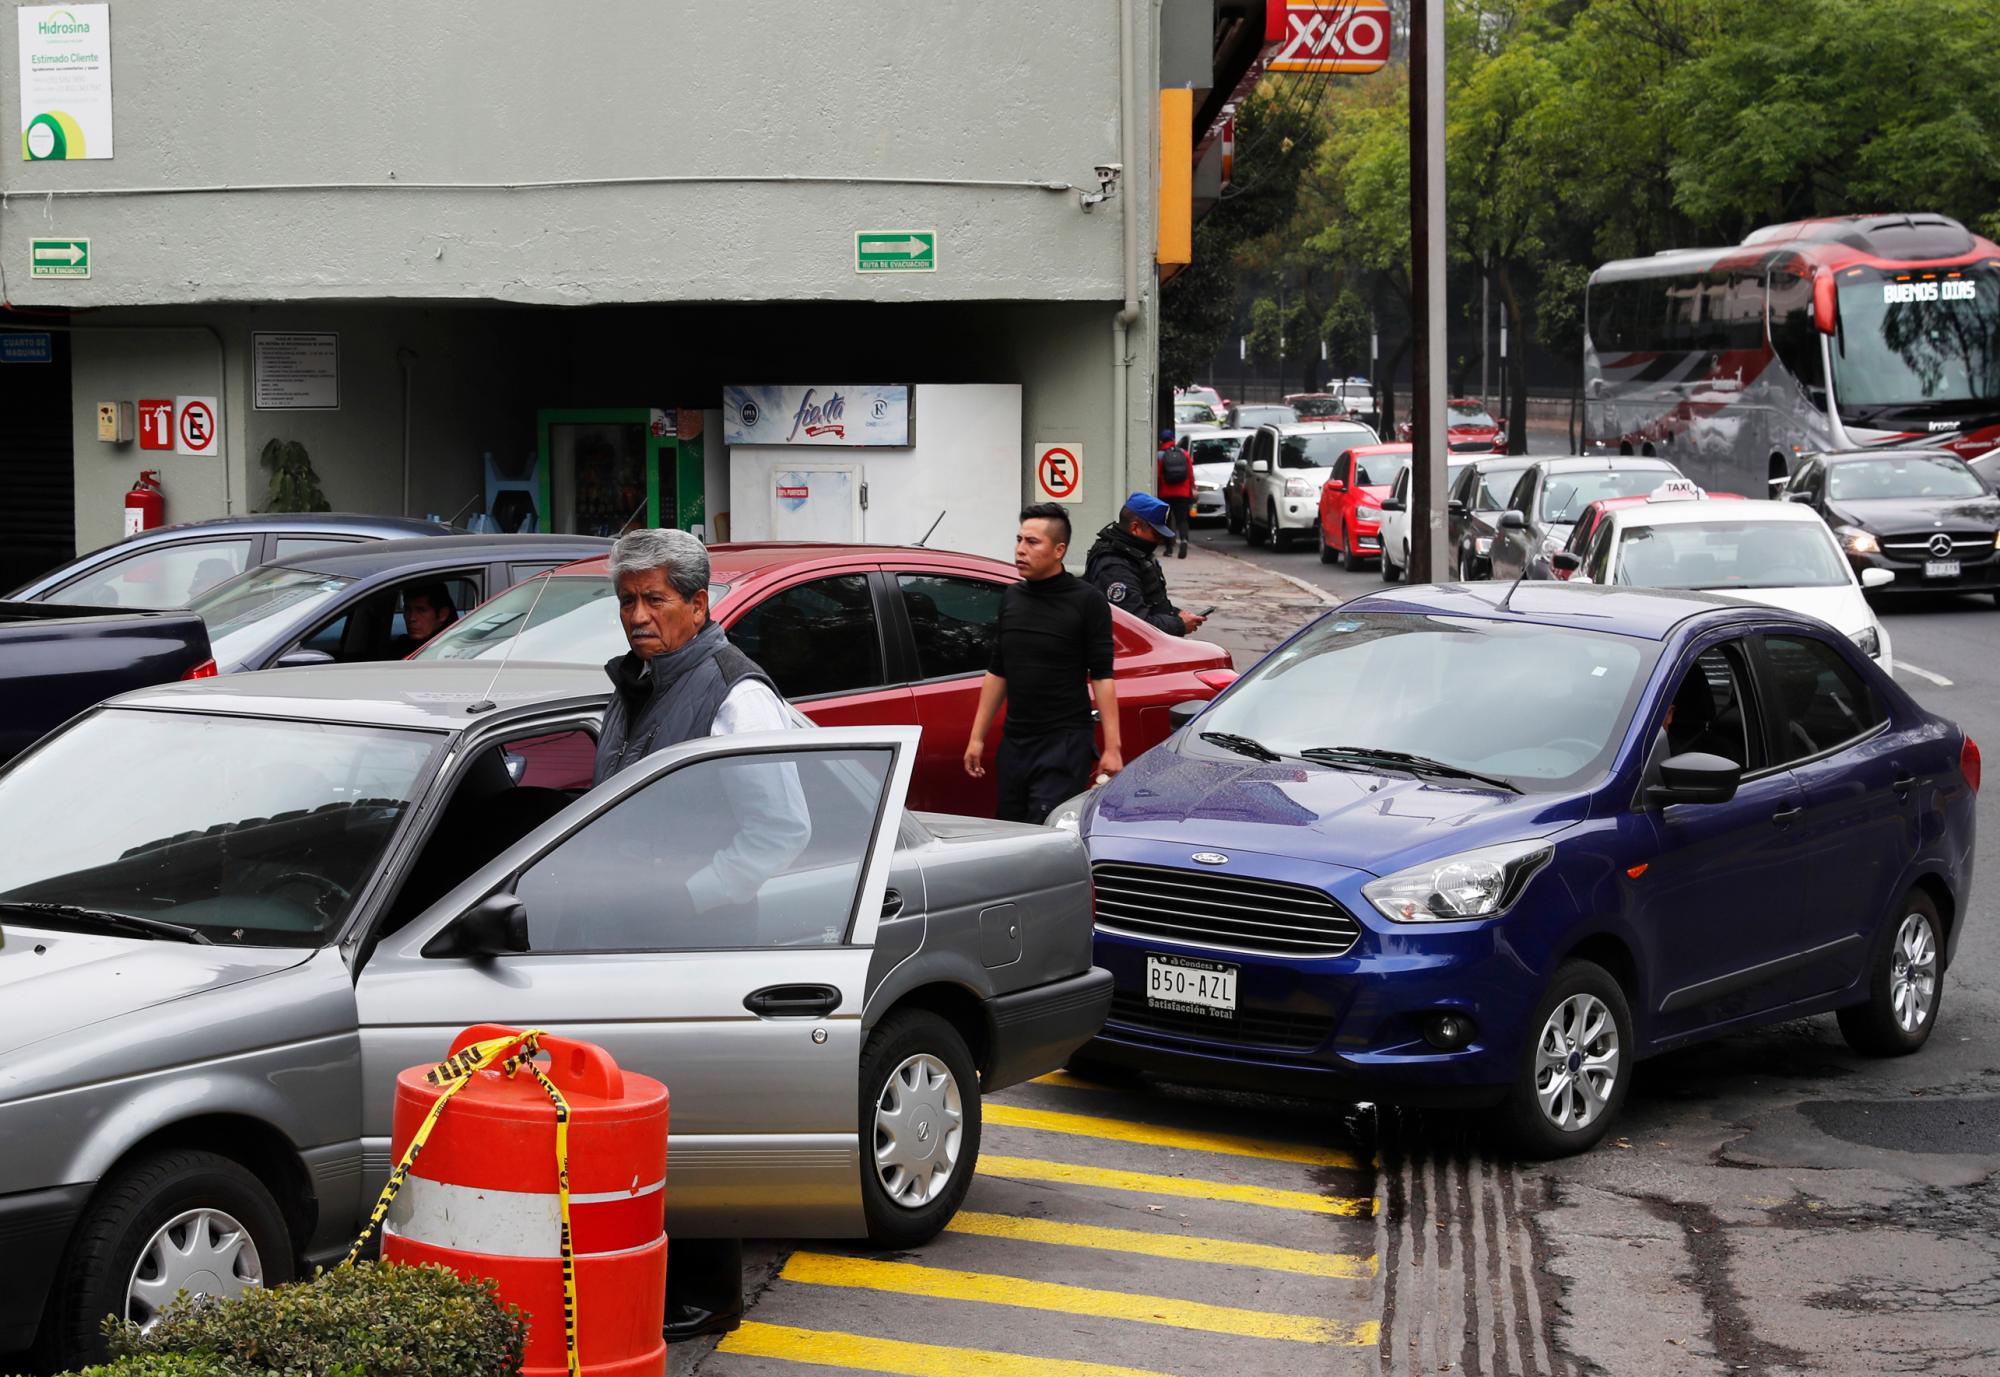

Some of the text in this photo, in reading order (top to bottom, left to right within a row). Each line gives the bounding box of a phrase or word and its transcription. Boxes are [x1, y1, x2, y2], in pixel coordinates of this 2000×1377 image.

[38, 22, 90, 34] Hidrosina
[1276, 10, 1383, 60] XXO
[32, 53, 98, 64] Estimado Cliente
[1884, 280, 1976, 303] BUENOS DIAS
[4, 338, 46, 347] CUARTO DE
[1667, 483, 1690, 492] TAXI
[1180, 958, 1214, 970] Condesa
[1152, 968, 1231, 1001] B50-AZL
[1148, 998, 1206, 1015] Satisfacción
[1209, 1007, 1232, 1019] Total
